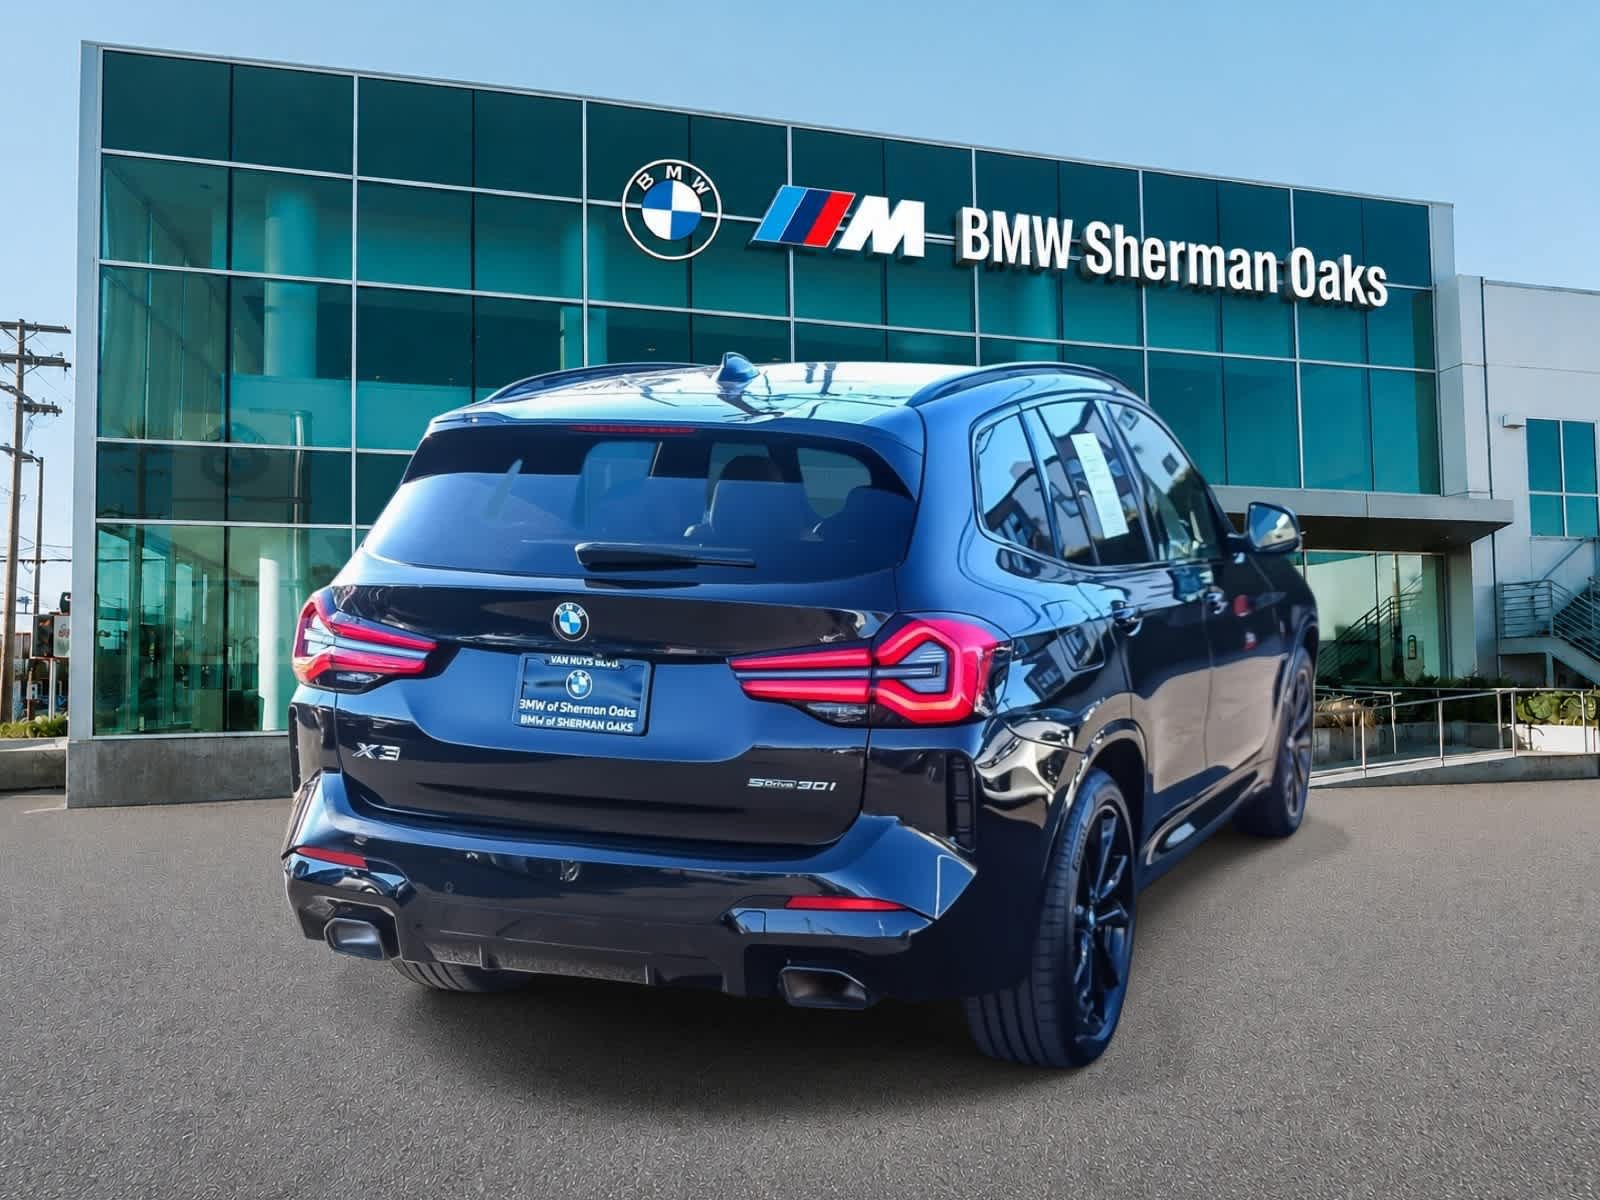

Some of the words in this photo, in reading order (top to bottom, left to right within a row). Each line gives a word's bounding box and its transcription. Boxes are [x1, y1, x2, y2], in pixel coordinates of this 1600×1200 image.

[636, 165, 711, 195] BMW
[835, 194, 925, 258] M
[959, 206, 1073, 271] BMW
[1084, 220, 1278, 295] Sherman
[1287, 246, 1389, 308] Oaks
[551, 655, 568, 665] VAN
[570, 656, 593, 666] NUYS
[519, 699, 544, 711] BMW
[547, 701, 559, 712] of
[559, 702, 606, 716] Sherman
[608, 705, 637, 718] Oaks
[520, 715, 544, 726] BMW
[545, 716, 555, 726] of
[556, 717, 605, 730] SHERMAN
[606, 721, 634, 733] OAKS
[352, 742, 400, 761] X3
